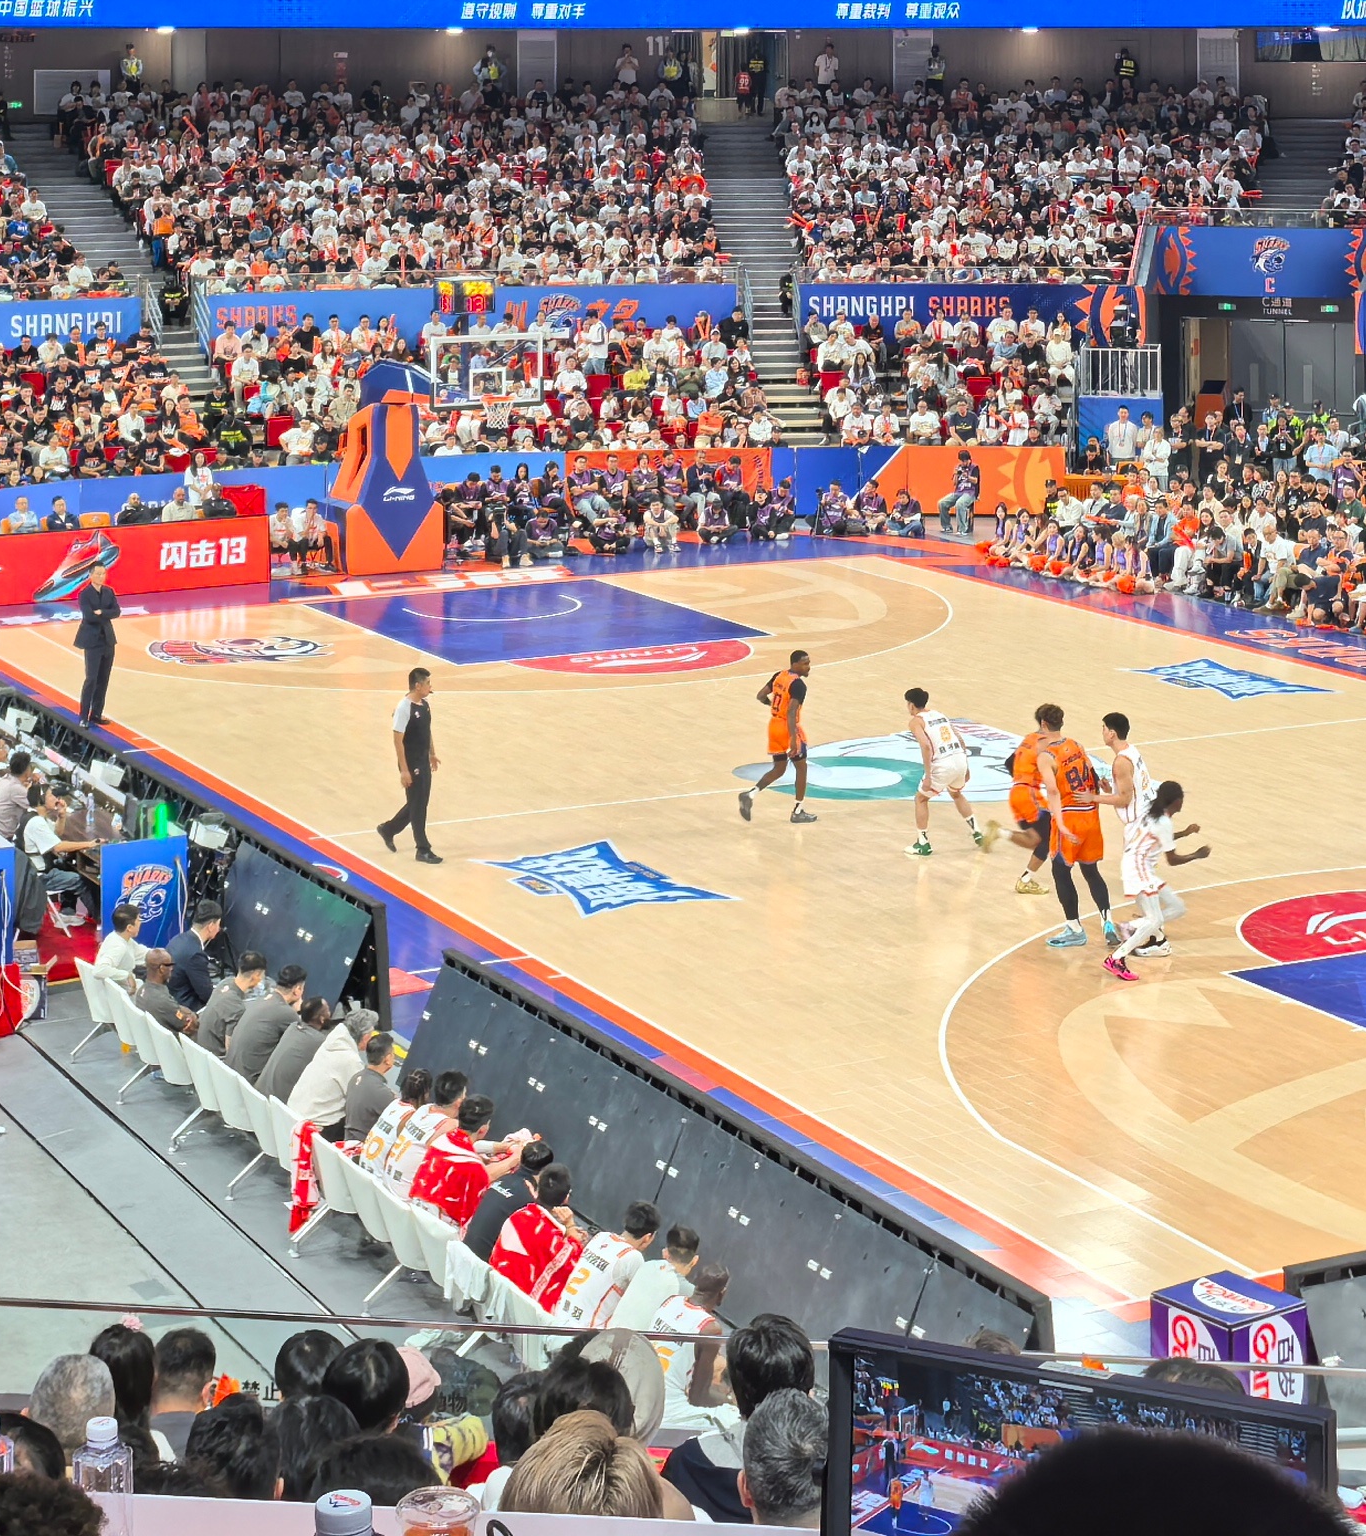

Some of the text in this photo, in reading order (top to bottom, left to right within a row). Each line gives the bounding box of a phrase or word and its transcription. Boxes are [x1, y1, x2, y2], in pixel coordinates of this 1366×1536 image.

[460, 1, 586, 22] 遵守规则 尊重对手
[835, 1, 961, 22] 尊重裁判 尊重观众
[646, 36, 663, 56] 11
[1264, 278, 1275, 293] C
[808, 295, 1010, 319] SHANGHAI SHARKS
[10, 304, 298, 339] SHANGHAI SHARKS
[159, 536, 247, 571] 闪击13
[569, 641, 699, 663] LI-NING
[564, 1267, 591, 1296] 2
